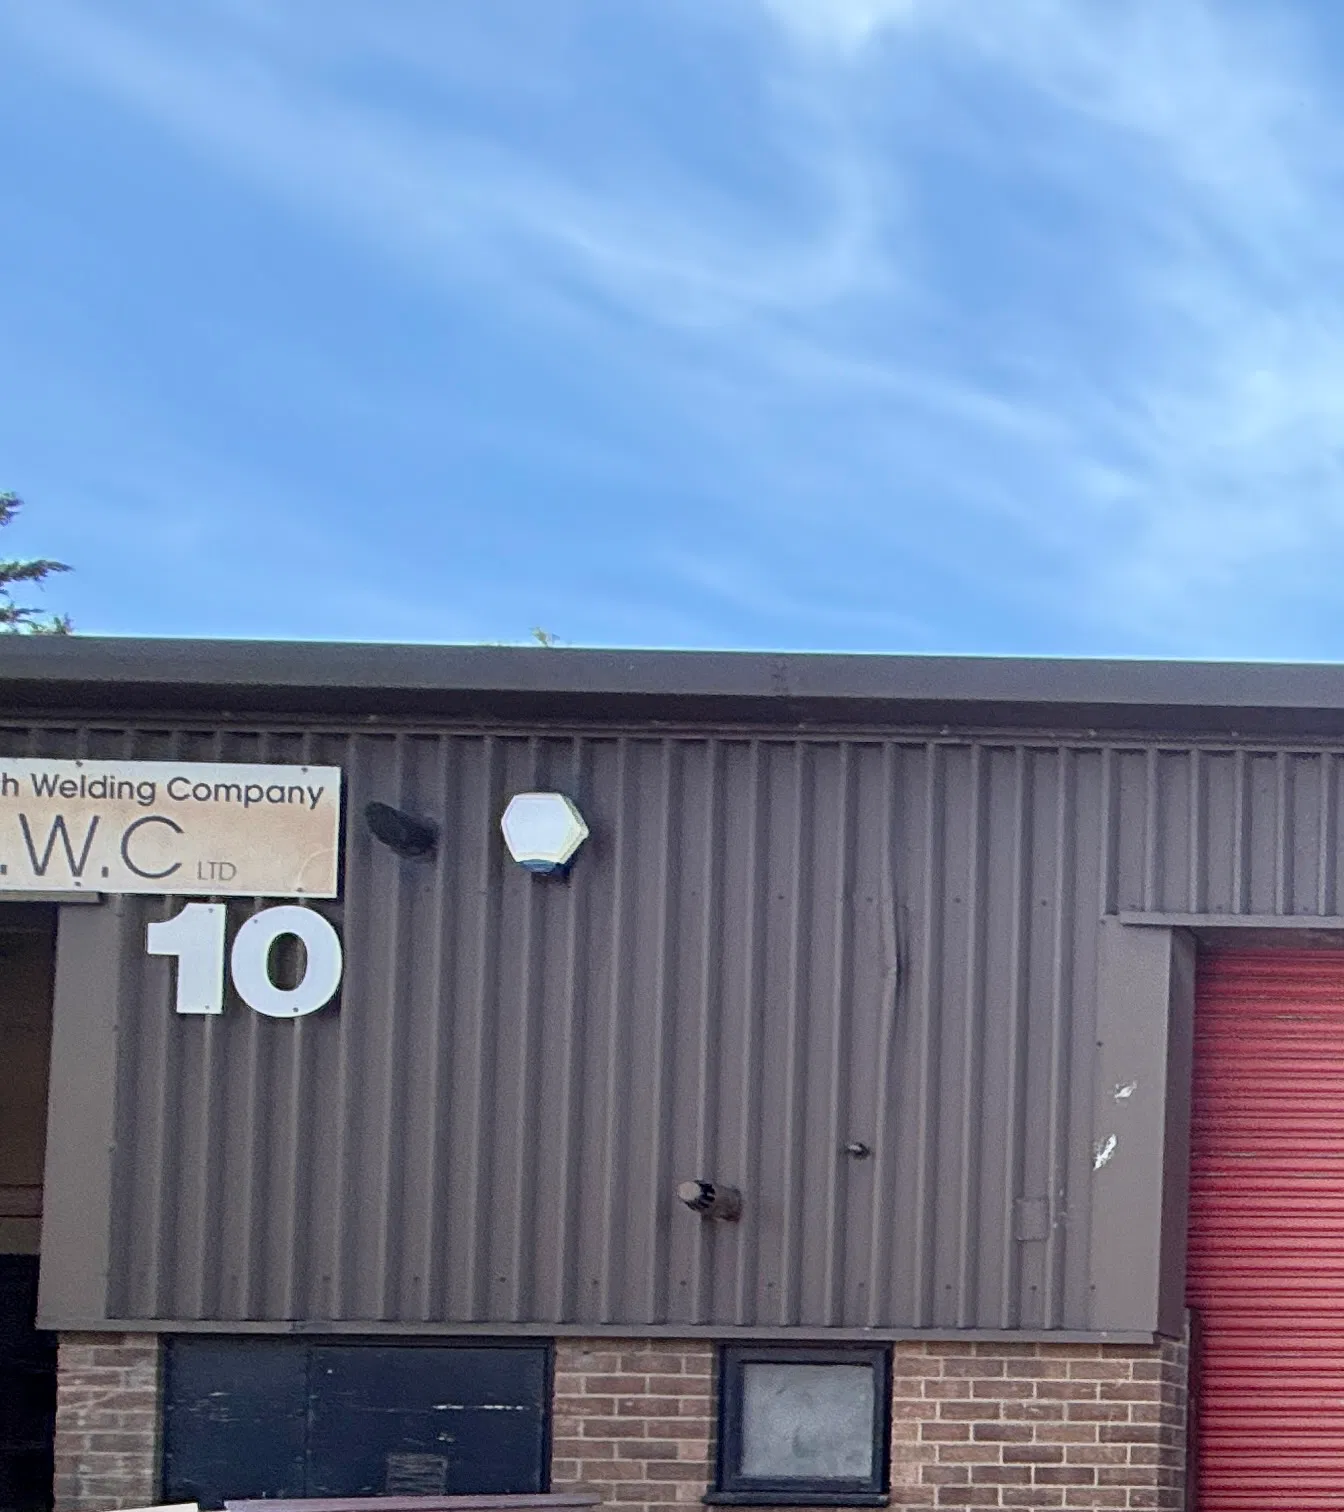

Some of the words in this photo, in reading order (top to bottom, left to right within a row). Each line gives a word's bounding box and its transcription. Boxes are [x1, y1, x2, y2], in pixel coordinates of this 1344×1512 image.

[32, 773, 155, 806] Welding
[167, 777, 324, 809] Company
[0, 813, 184, 879] .W.C
[197, 861, 237, 881] LTD
[147, 902, 343, 1018] 10
